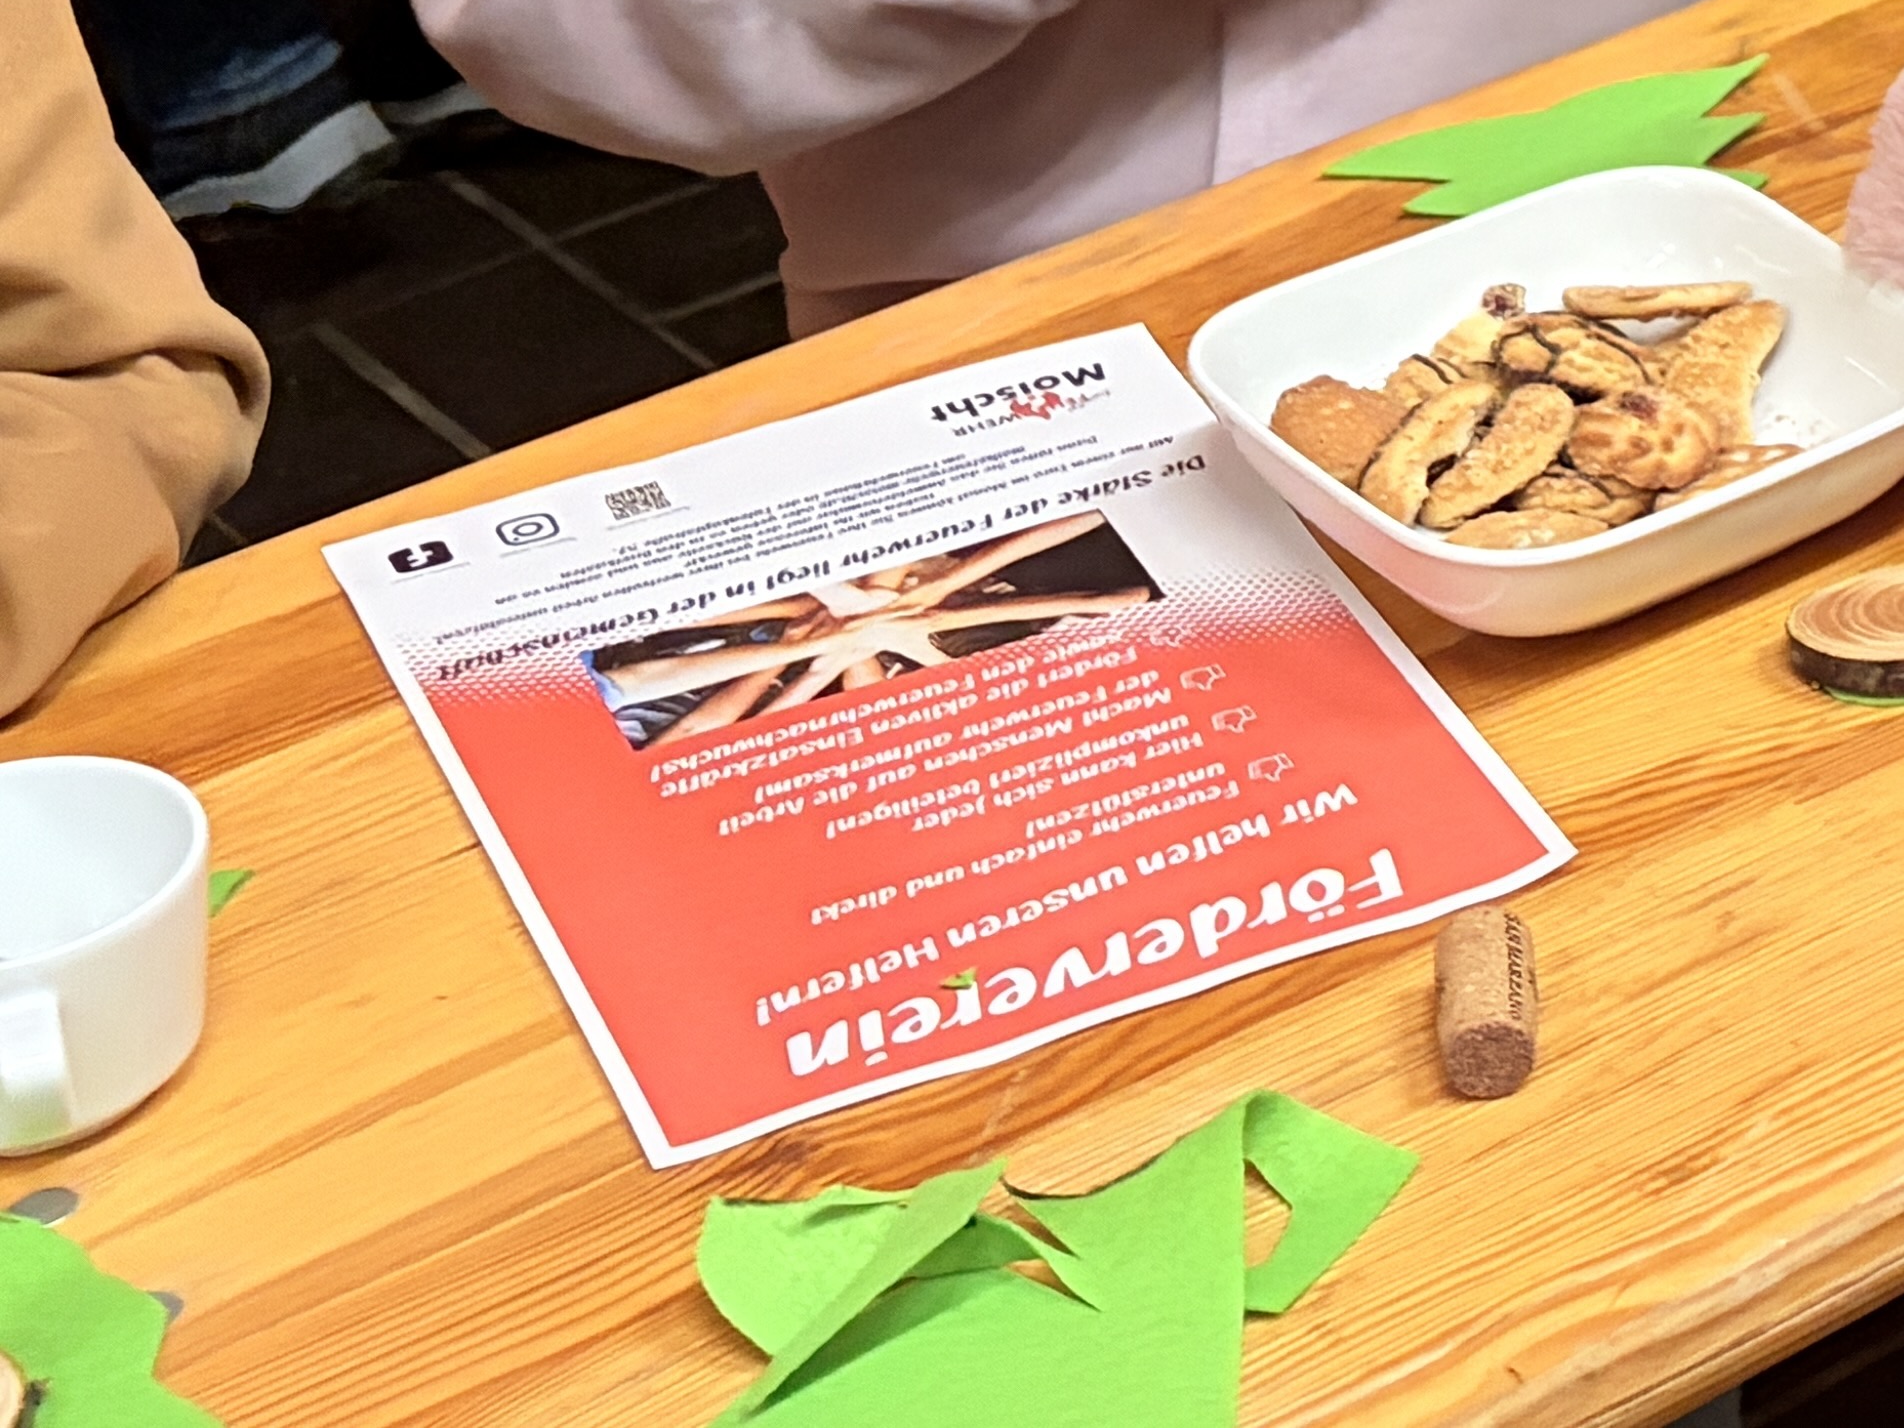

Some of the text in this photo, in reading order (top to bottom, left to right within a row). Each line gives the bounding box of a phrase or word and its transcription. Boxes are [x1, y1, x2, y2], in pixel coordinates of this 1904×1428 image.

[931, 362, 1105, 421] Moischt
[434, 454, 1205, 682] Die Stärke der Feuerwehr liegt in der Gemeinschaft
[646, 670, 976, 783] Feuerwehrnachwuchs!
[660, 645, 1136, 796] Fördert die aktiven Einsatzkräfte
[978, 653, 1037, 686] den
[719, 687, 1171, 835] Macht Menschen auf die Arbeit
[754, 670, 1158, 803] der Feuerwehr aufmerksam!
[826, 714, 1188, 839] unkompliziert beteiligen!
[993, 777, 1053, 806] sich
[1060, 751, 1136, 785] kann
[1144, 732, 1203, 759] Hier
[811, 780, 1239, 924] Feuerwehr einfach und direkt
[1025, 762, 1225, 838] unterstützen!
[756, 783, 1357, 1026] Wir helfen unseren Helfern!
[786, 848, 1403, 1075] Förderverein
[1504, 913, 1524, 1021] SAN MARZANO
